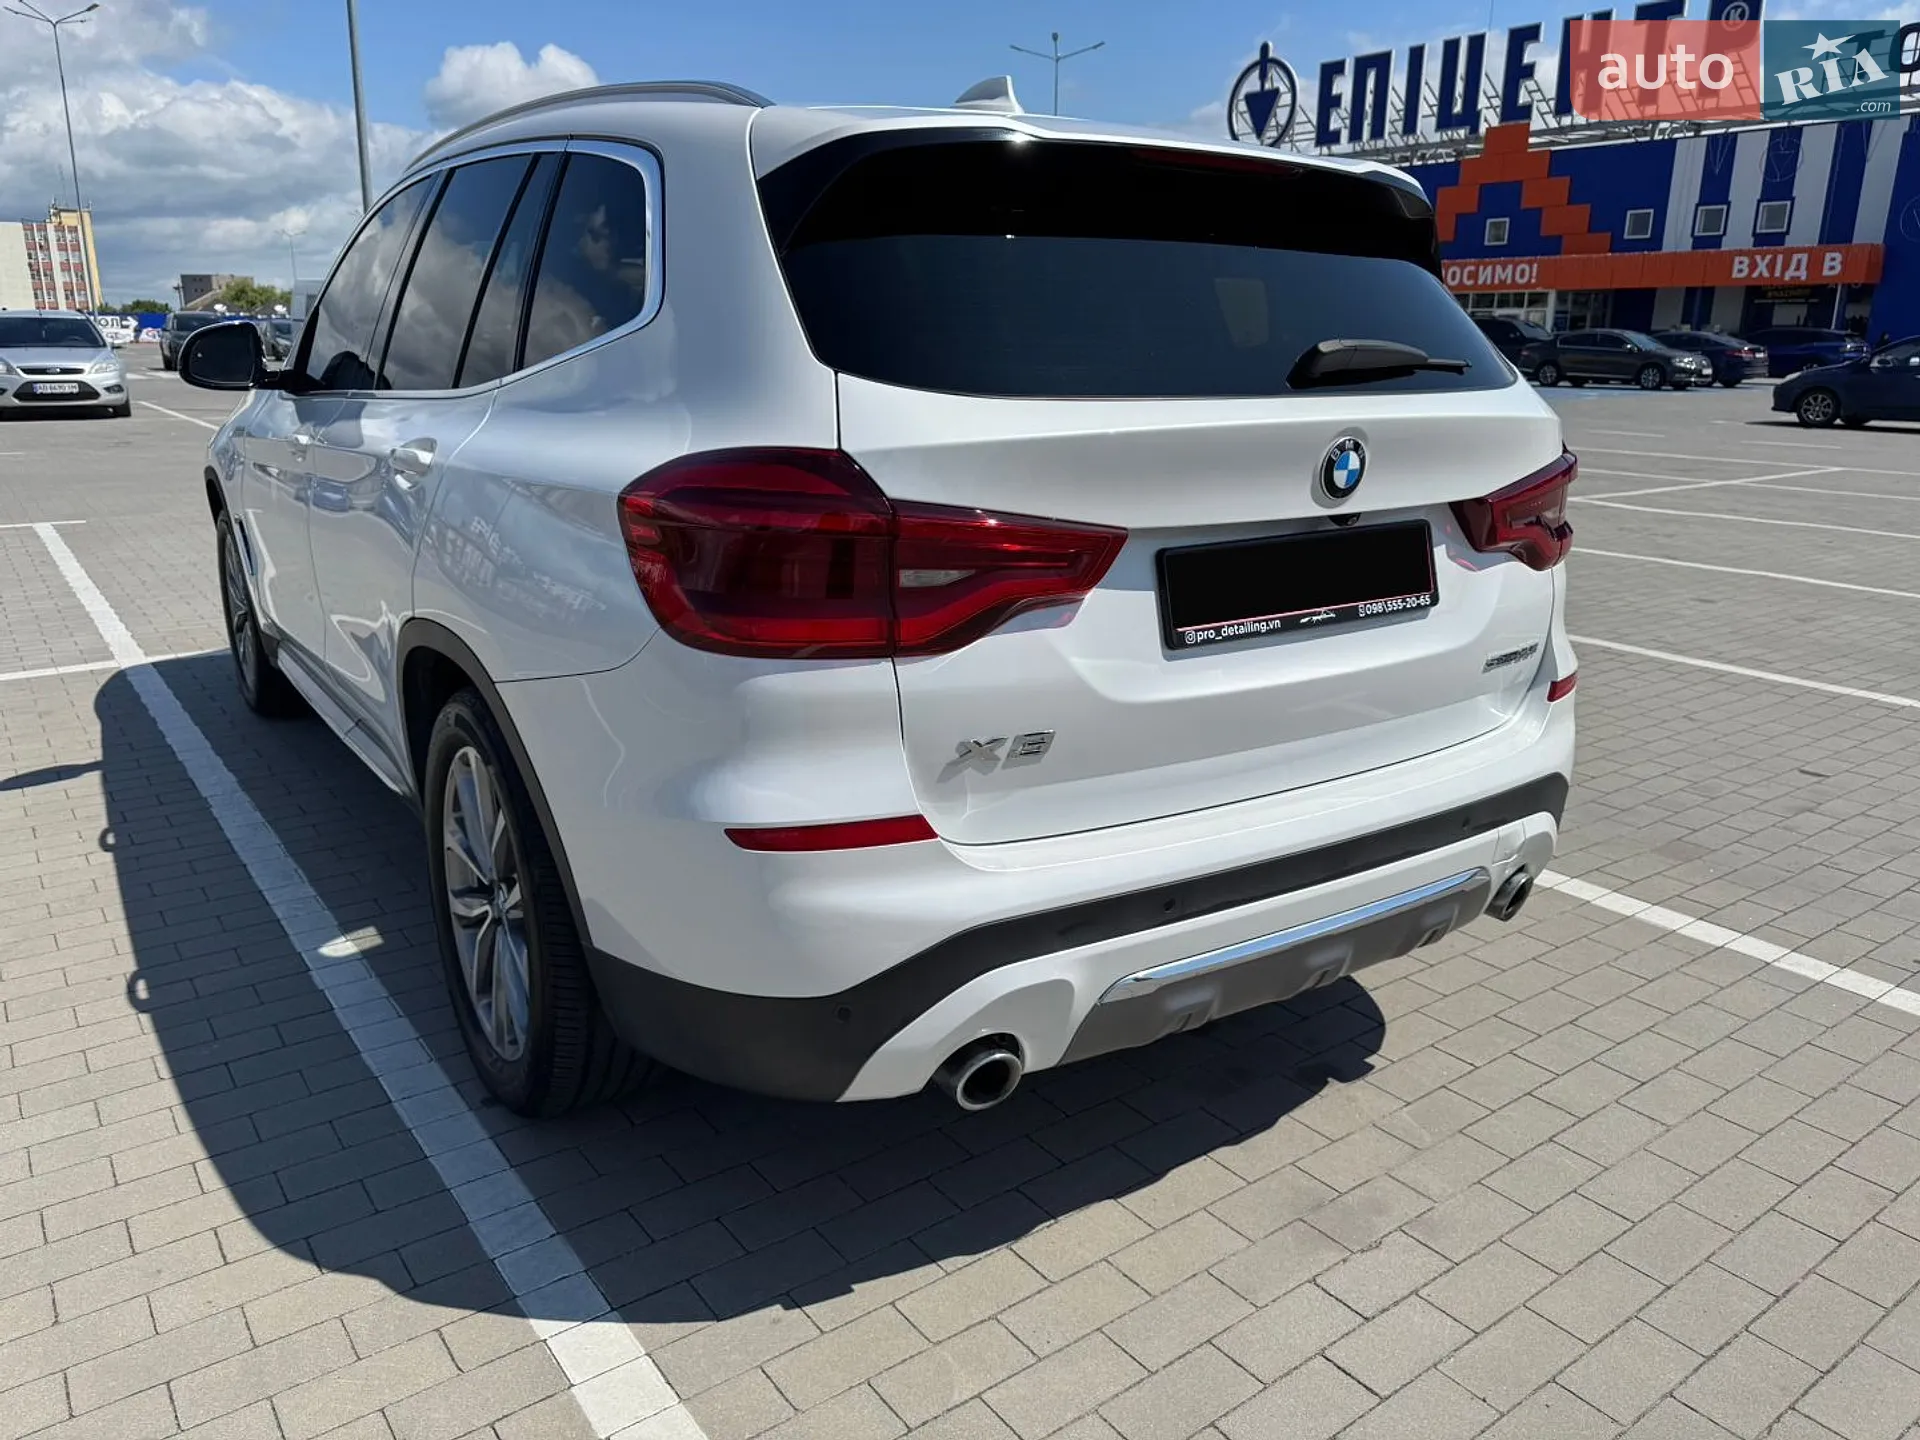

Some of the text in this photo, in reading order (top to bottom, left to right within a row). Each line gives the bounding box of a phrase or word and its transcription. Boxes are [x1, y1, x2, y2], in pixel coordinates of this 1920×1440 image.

[1441, 263, 1538, 286] ОСИМО!
[1731, 251, 1843, 281] ВХІД В
[1330, 439, 1366, 461] BMW
